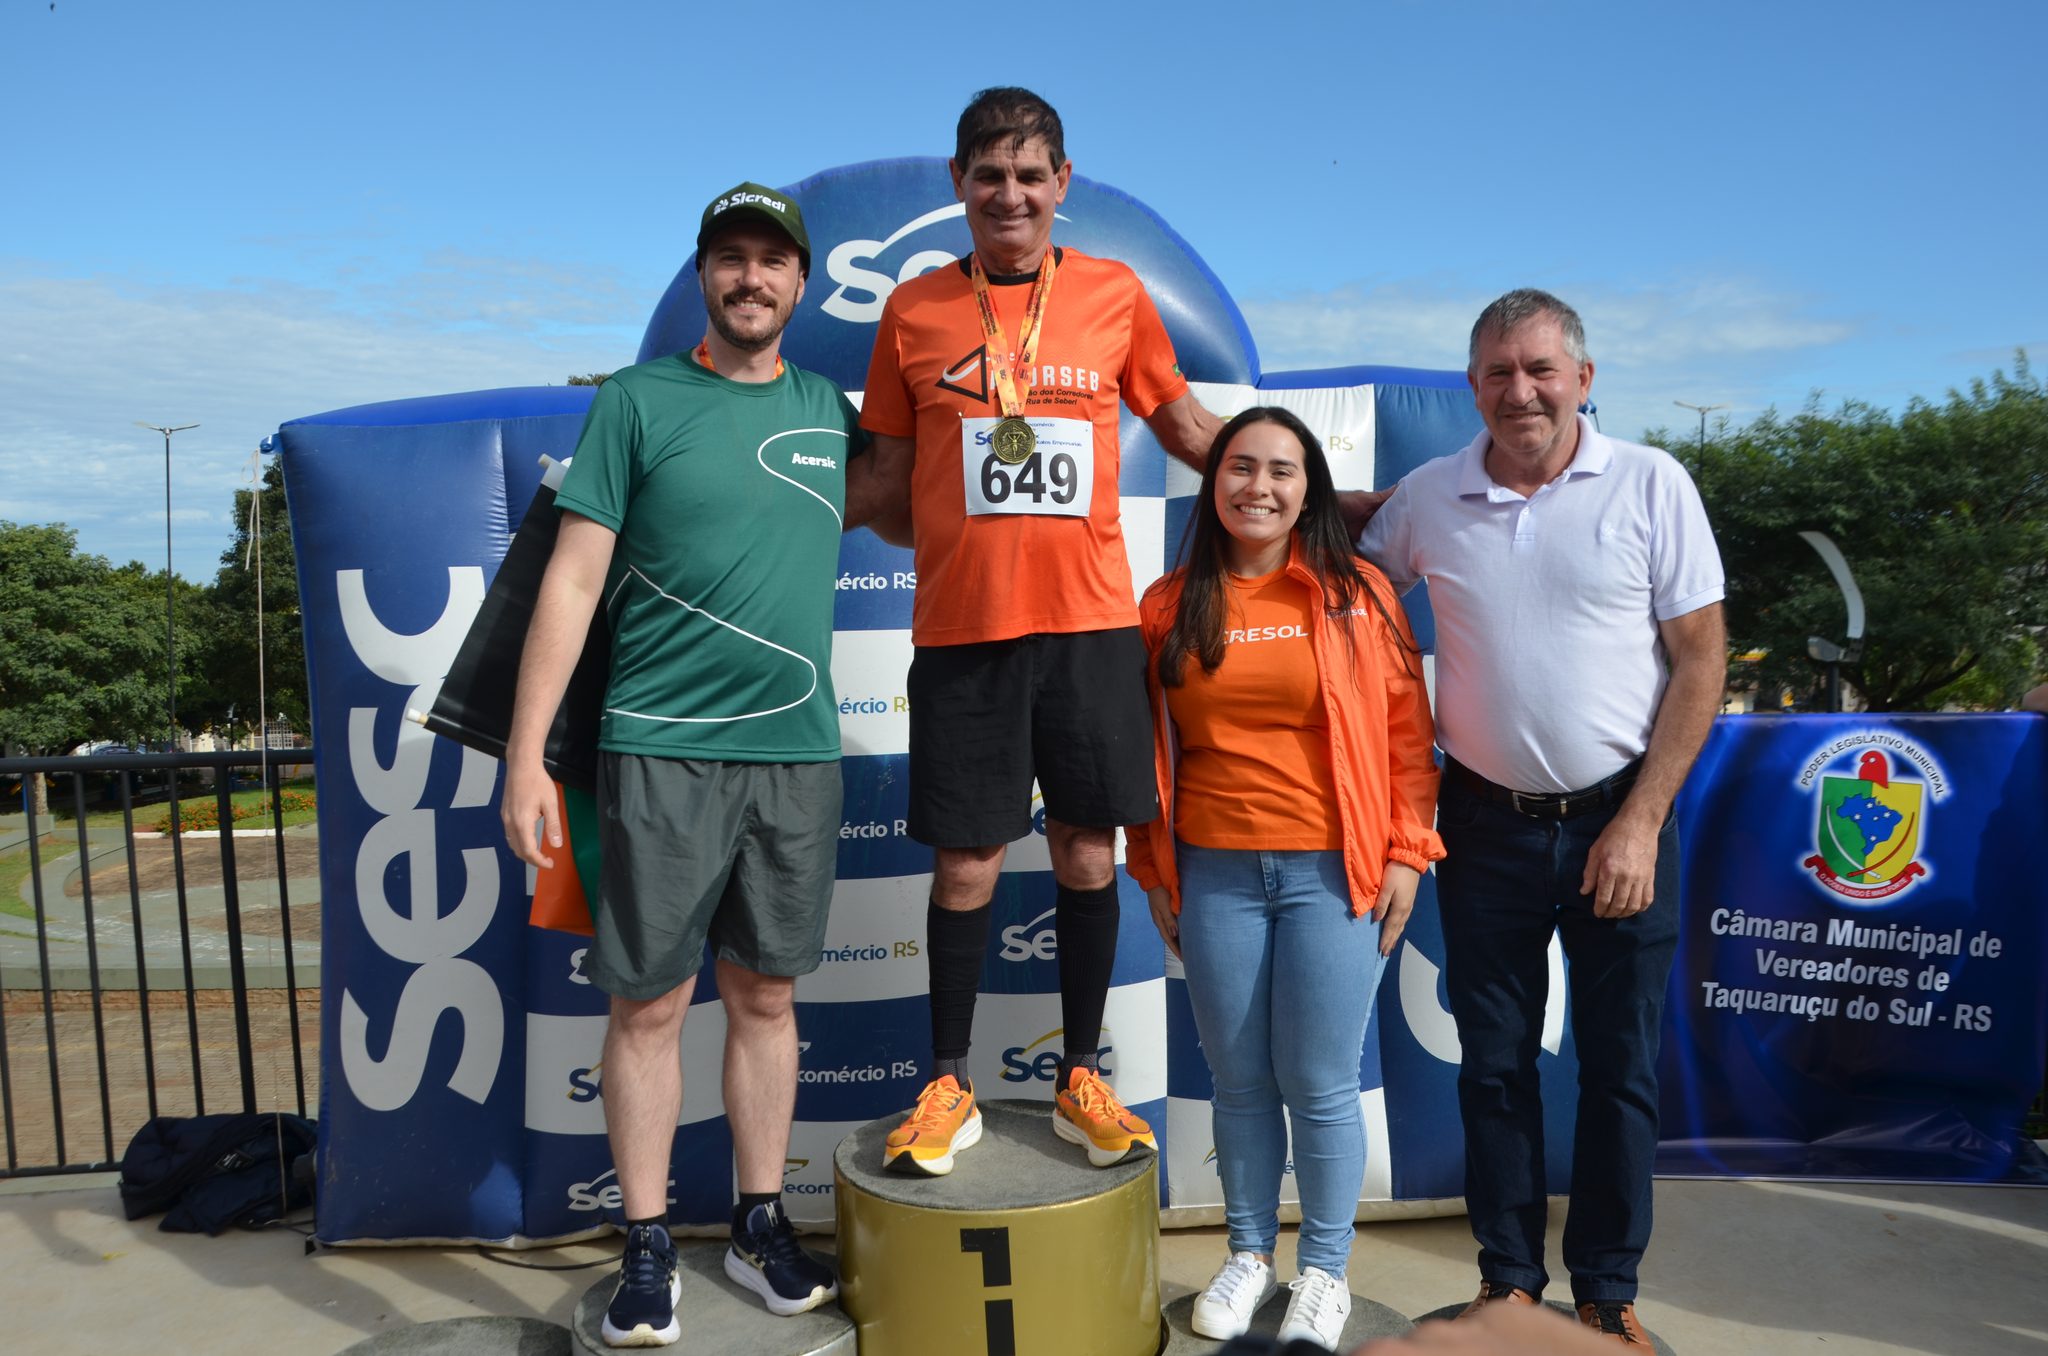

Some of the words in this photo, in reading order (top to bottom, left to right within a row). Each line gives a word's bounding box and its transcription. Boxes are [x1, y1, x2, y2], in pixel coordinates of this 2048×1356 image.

[729, 191, 787, 213] Sicredi
[1056, 387, 1094, 400] Corredores
[1329, 435, 1353, 451] RS
[791, 452, 837, 469] Acersic
[981, 452, 1078, 504] 649
[835, 572, 888, 590] ércio
[893, 572, 917, 589] RS
[838, 697, 888, 714] ércio
[893, 696, 910, 713] R
[1801, 751, 1830, 787] PODER
[1829, 735, 1904, 755] LEGISLATIVO
[1904, 745, 1945, 796] MUNICIPAL
[837, 821, 888, 839] ércio
[1710, 908, 1818, 944] Câmara
[1826, 918, 1963, 960] Municipal
[1969, 930, 2002, 958] de
[893, 940, 919, 958] RS
[1755, 948, 1910, 988] Vereadores
[1917, 965, 1950, 992] de
[1702, 981, 1839, 1022] Taquaruçu
[1846, 995, 1880, 1021] do
[1888, 998, 1934, 1027] Sul
[1953, 1003, 1993, 1032] RS
[891, 1060, 918, 1079] RS
[999, 1046, 1113, 1083] Sec
[782, 1180, 834, 1195] ecom
[960, 1226, 1016, 1356] 1
